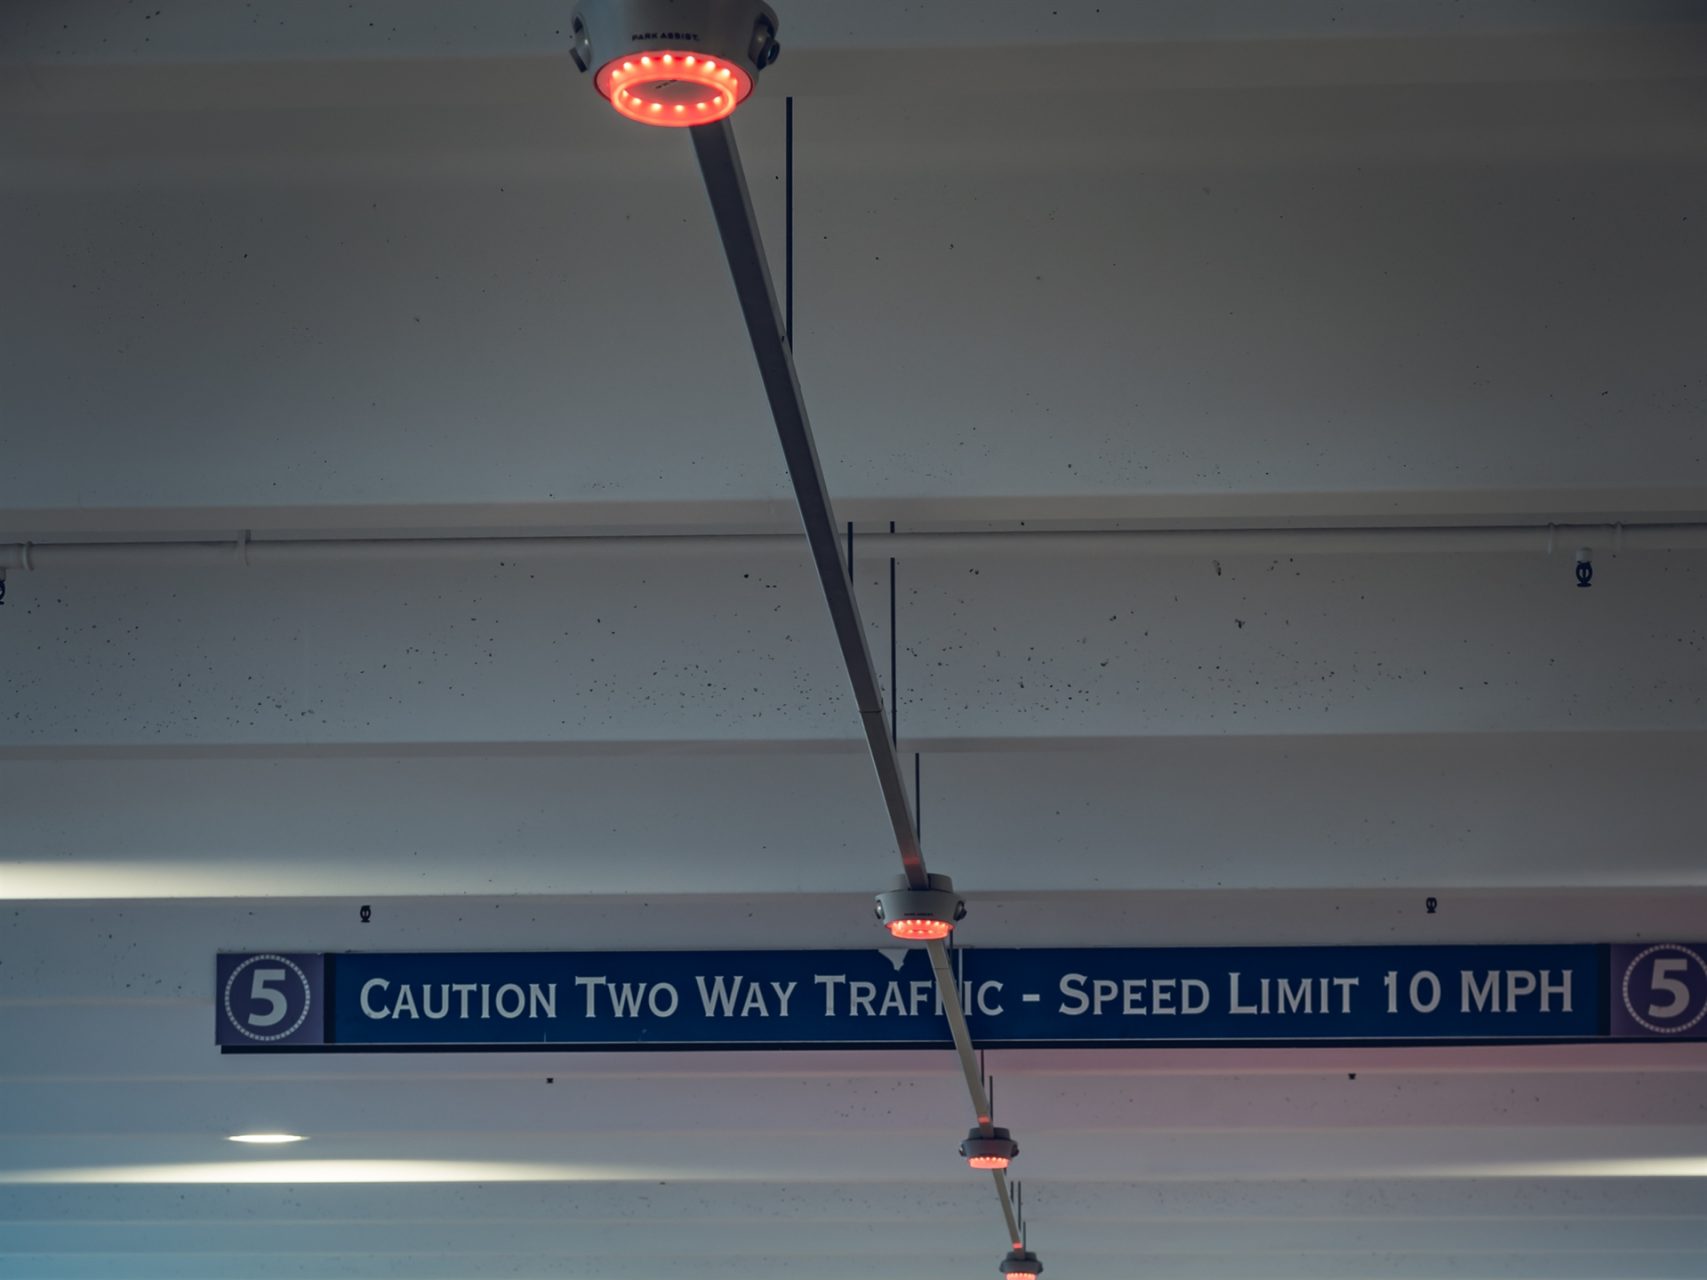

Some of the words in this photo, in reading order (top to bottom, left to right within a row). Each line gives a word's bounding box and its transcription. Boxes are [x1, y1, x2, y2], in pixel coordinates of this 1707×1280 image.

[247, 968, 289, 1026] 5
[359, 977, 558, 1020] CAUTION
[575, 975, 680, 1018] TWO
[695, 975, 798, 1018] WAY
[1022, 993, 1041, 1002] -
[1059, 973, 1211, 1016] SPEED
[1228, 972, 1360, 1015] LIMIT
[1384, 970, 1442, 1014] 10
[1460, 969, 1574, 1013] MPH
[1647, 957, 1690, 1019] 5
